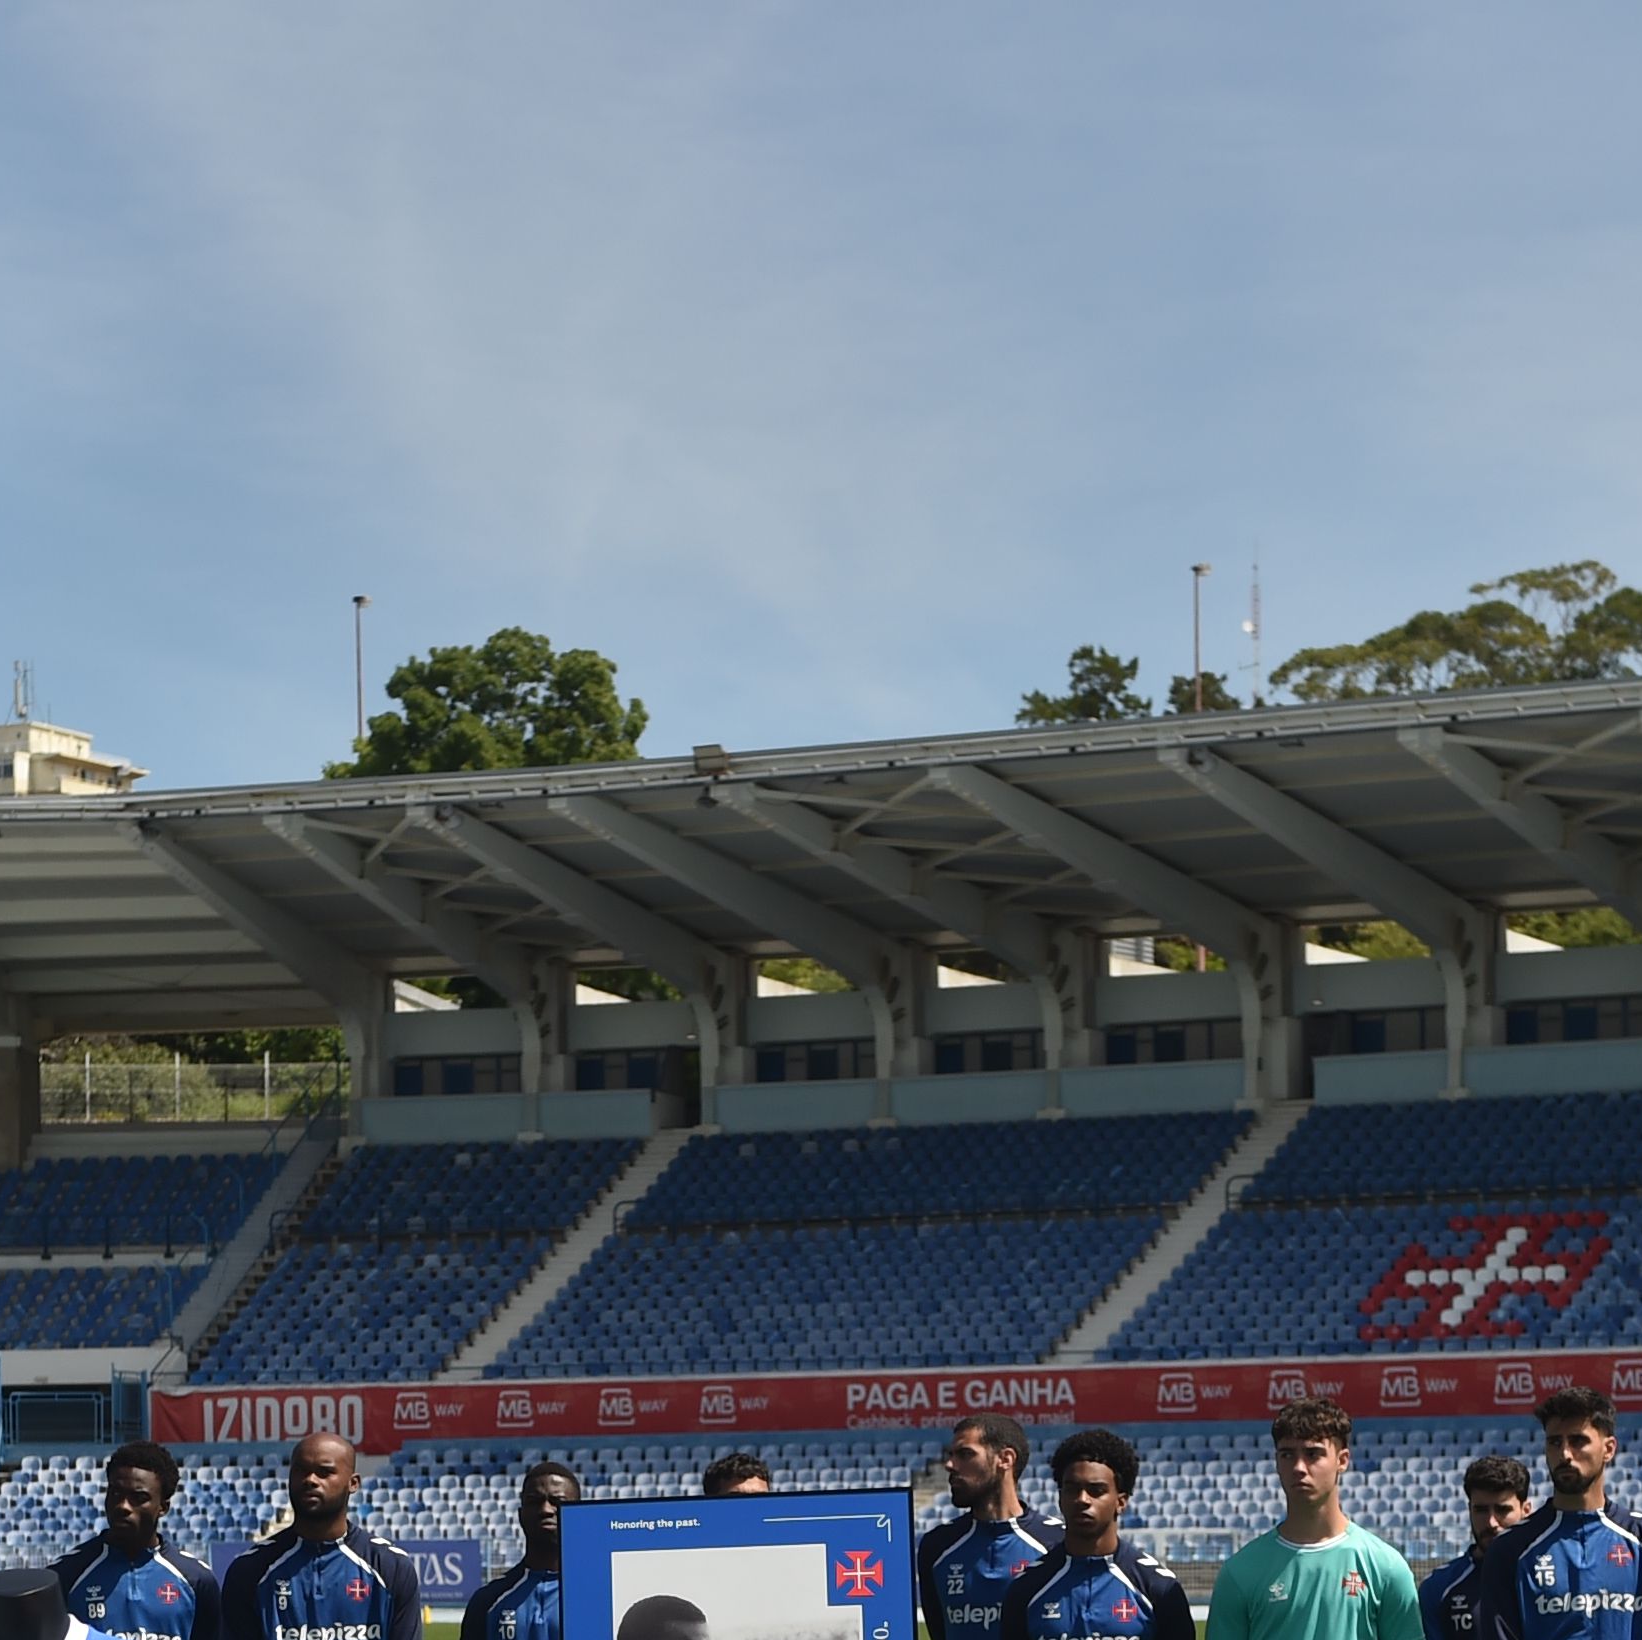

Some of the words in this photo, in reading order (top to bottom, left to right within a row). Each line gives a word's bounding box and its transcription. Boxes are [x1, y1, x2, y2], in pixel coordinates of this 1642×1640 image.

[1268, 1379, 1306, 1400] MB
[1312, 1382, 1345, 1396] WAY
[1380, 1376, 1419, 1397] MB
[1424, 1378, 1458, 1392] WAY
[1494, 1372, 1535, 1394] MB
[1540, 1375, 1574, 1389] WAY
[846, 1382, 931, 1411] PAGA
[937, 1380, 957, 1409] E
[964, 1377, 1076, 1408] GANHA
[1158, 1384, 1195, 1404] MB
[1200, 1385, 1233, 1399] WAY
[393, 1399, 430, 1421] MB
[434, 1403, 465, 1418] WAY
[497, 1399, 533, 1419] MB
[537, 1402, 567, 1416] WAY
[598, 1397, 634, 1417] MB
[639, 1399, 669, 1413] WAY
[699, 1395, 735, 1415] MB
[739, 1396, 770, 1410] WAY
[610, 1520, 655, 1531] Honoring
[657, 1519, 673, 1528] the
[675, 1518, 701, 1529] past.
[409, 1552, 464, 1586] TAS
[1535, 1571, 1555, 1587] 15
[947, 1578, 964, 1595] 22
[88, 1603, 106, 1618] 89
[278, 1595, 288, 1610] 9
[947, 1602, 1003, 1630] telepi
[498, 1625, 515, 1640] 10
